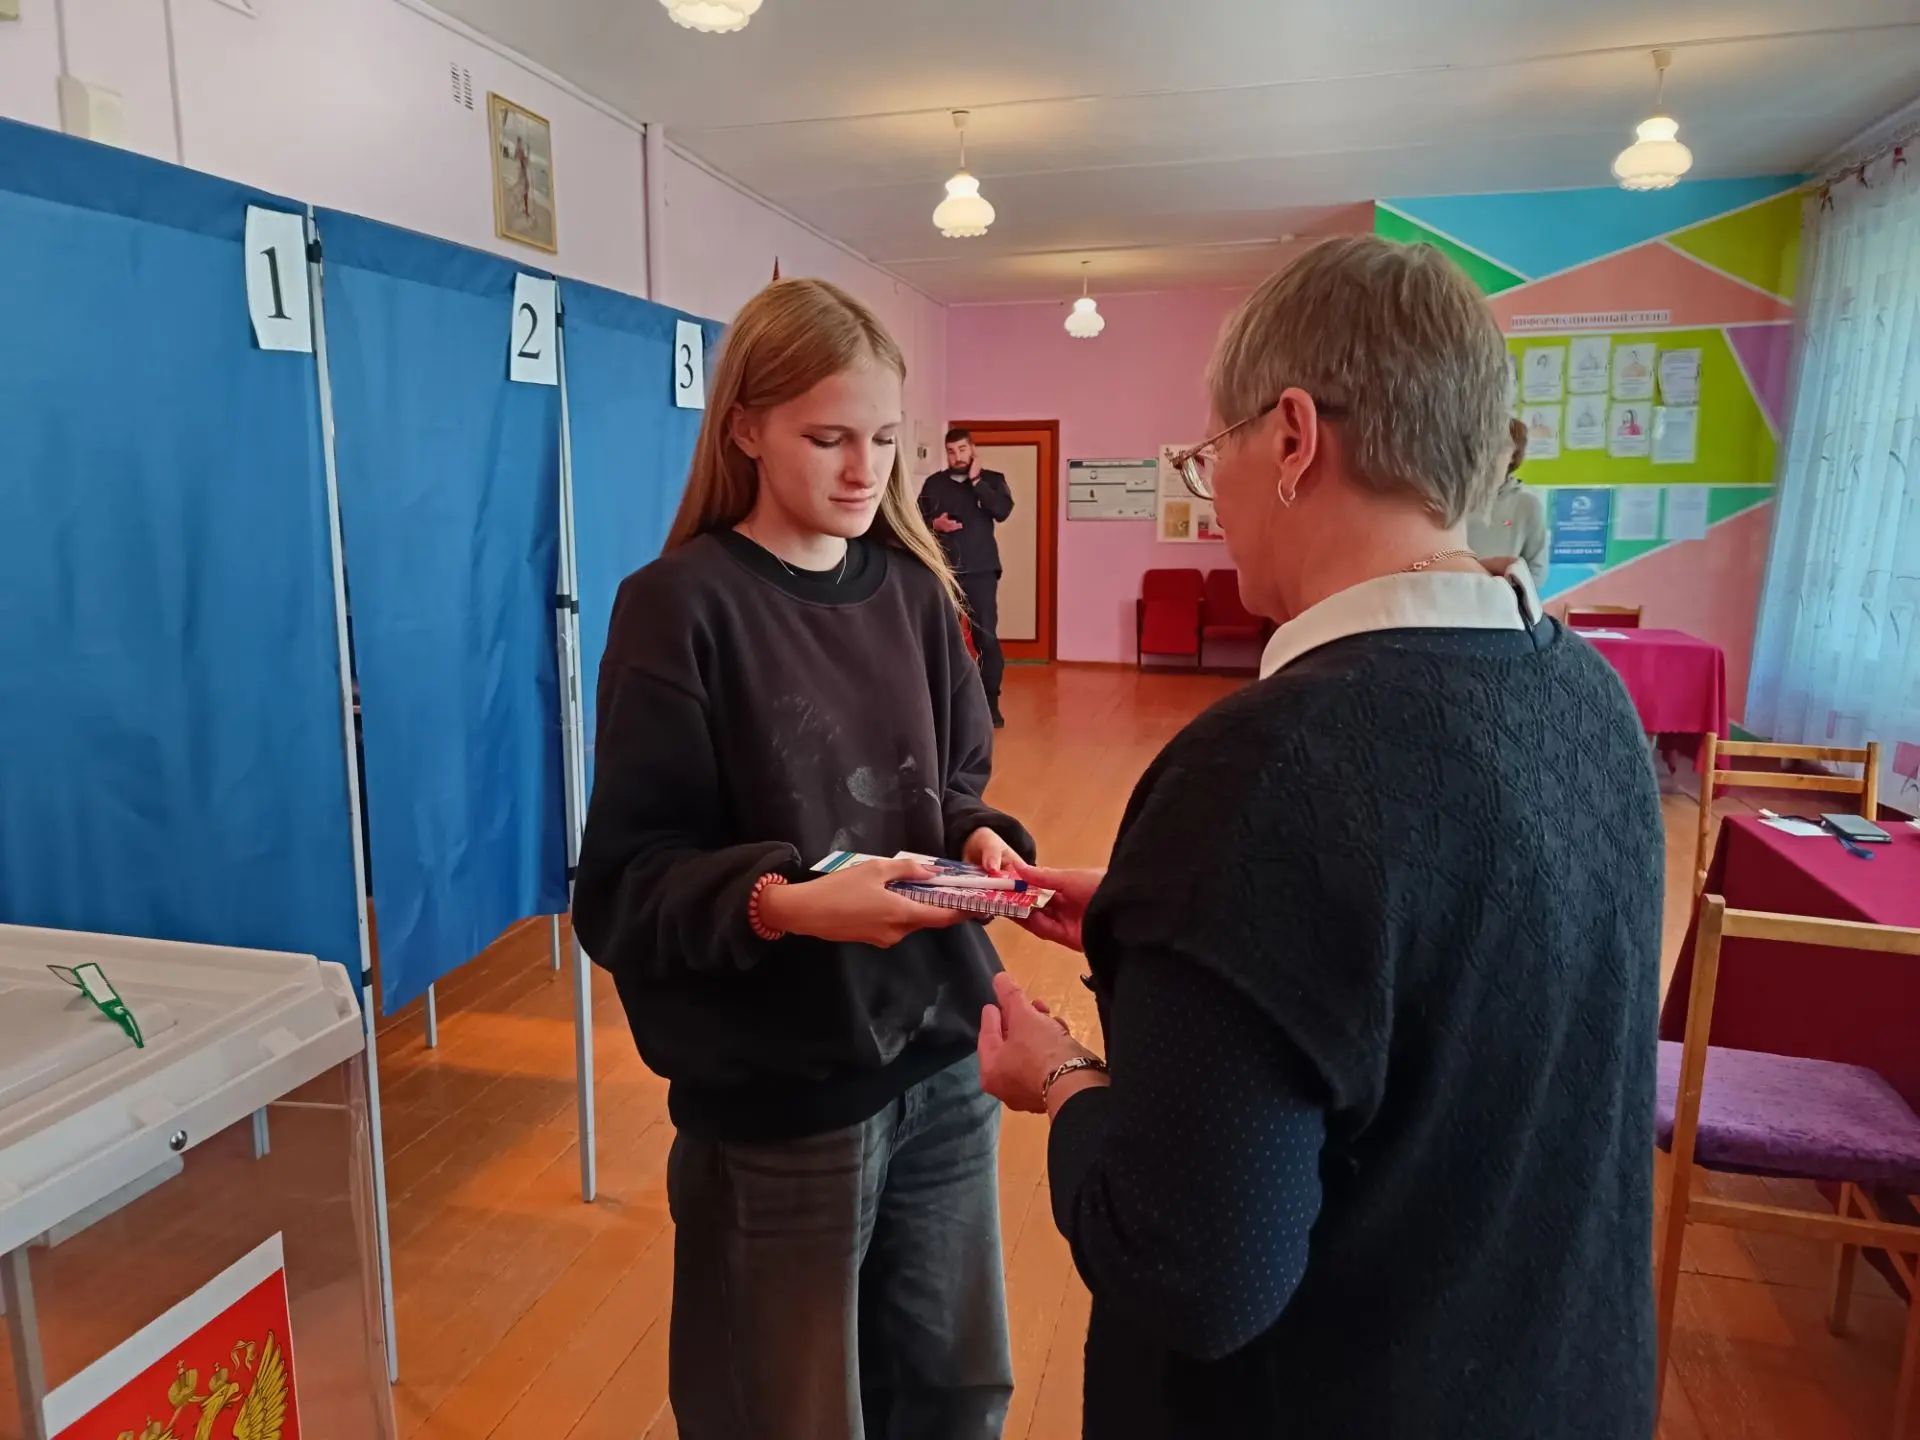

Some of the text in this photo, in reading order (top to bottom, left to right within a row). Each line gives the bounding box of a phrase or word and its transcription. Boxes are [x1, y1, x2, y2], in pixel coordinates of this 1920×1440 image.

[259, 245, 292, 321] 1
[516, 302, 542, 360] 2
[679, 342, 694, 390] 3
